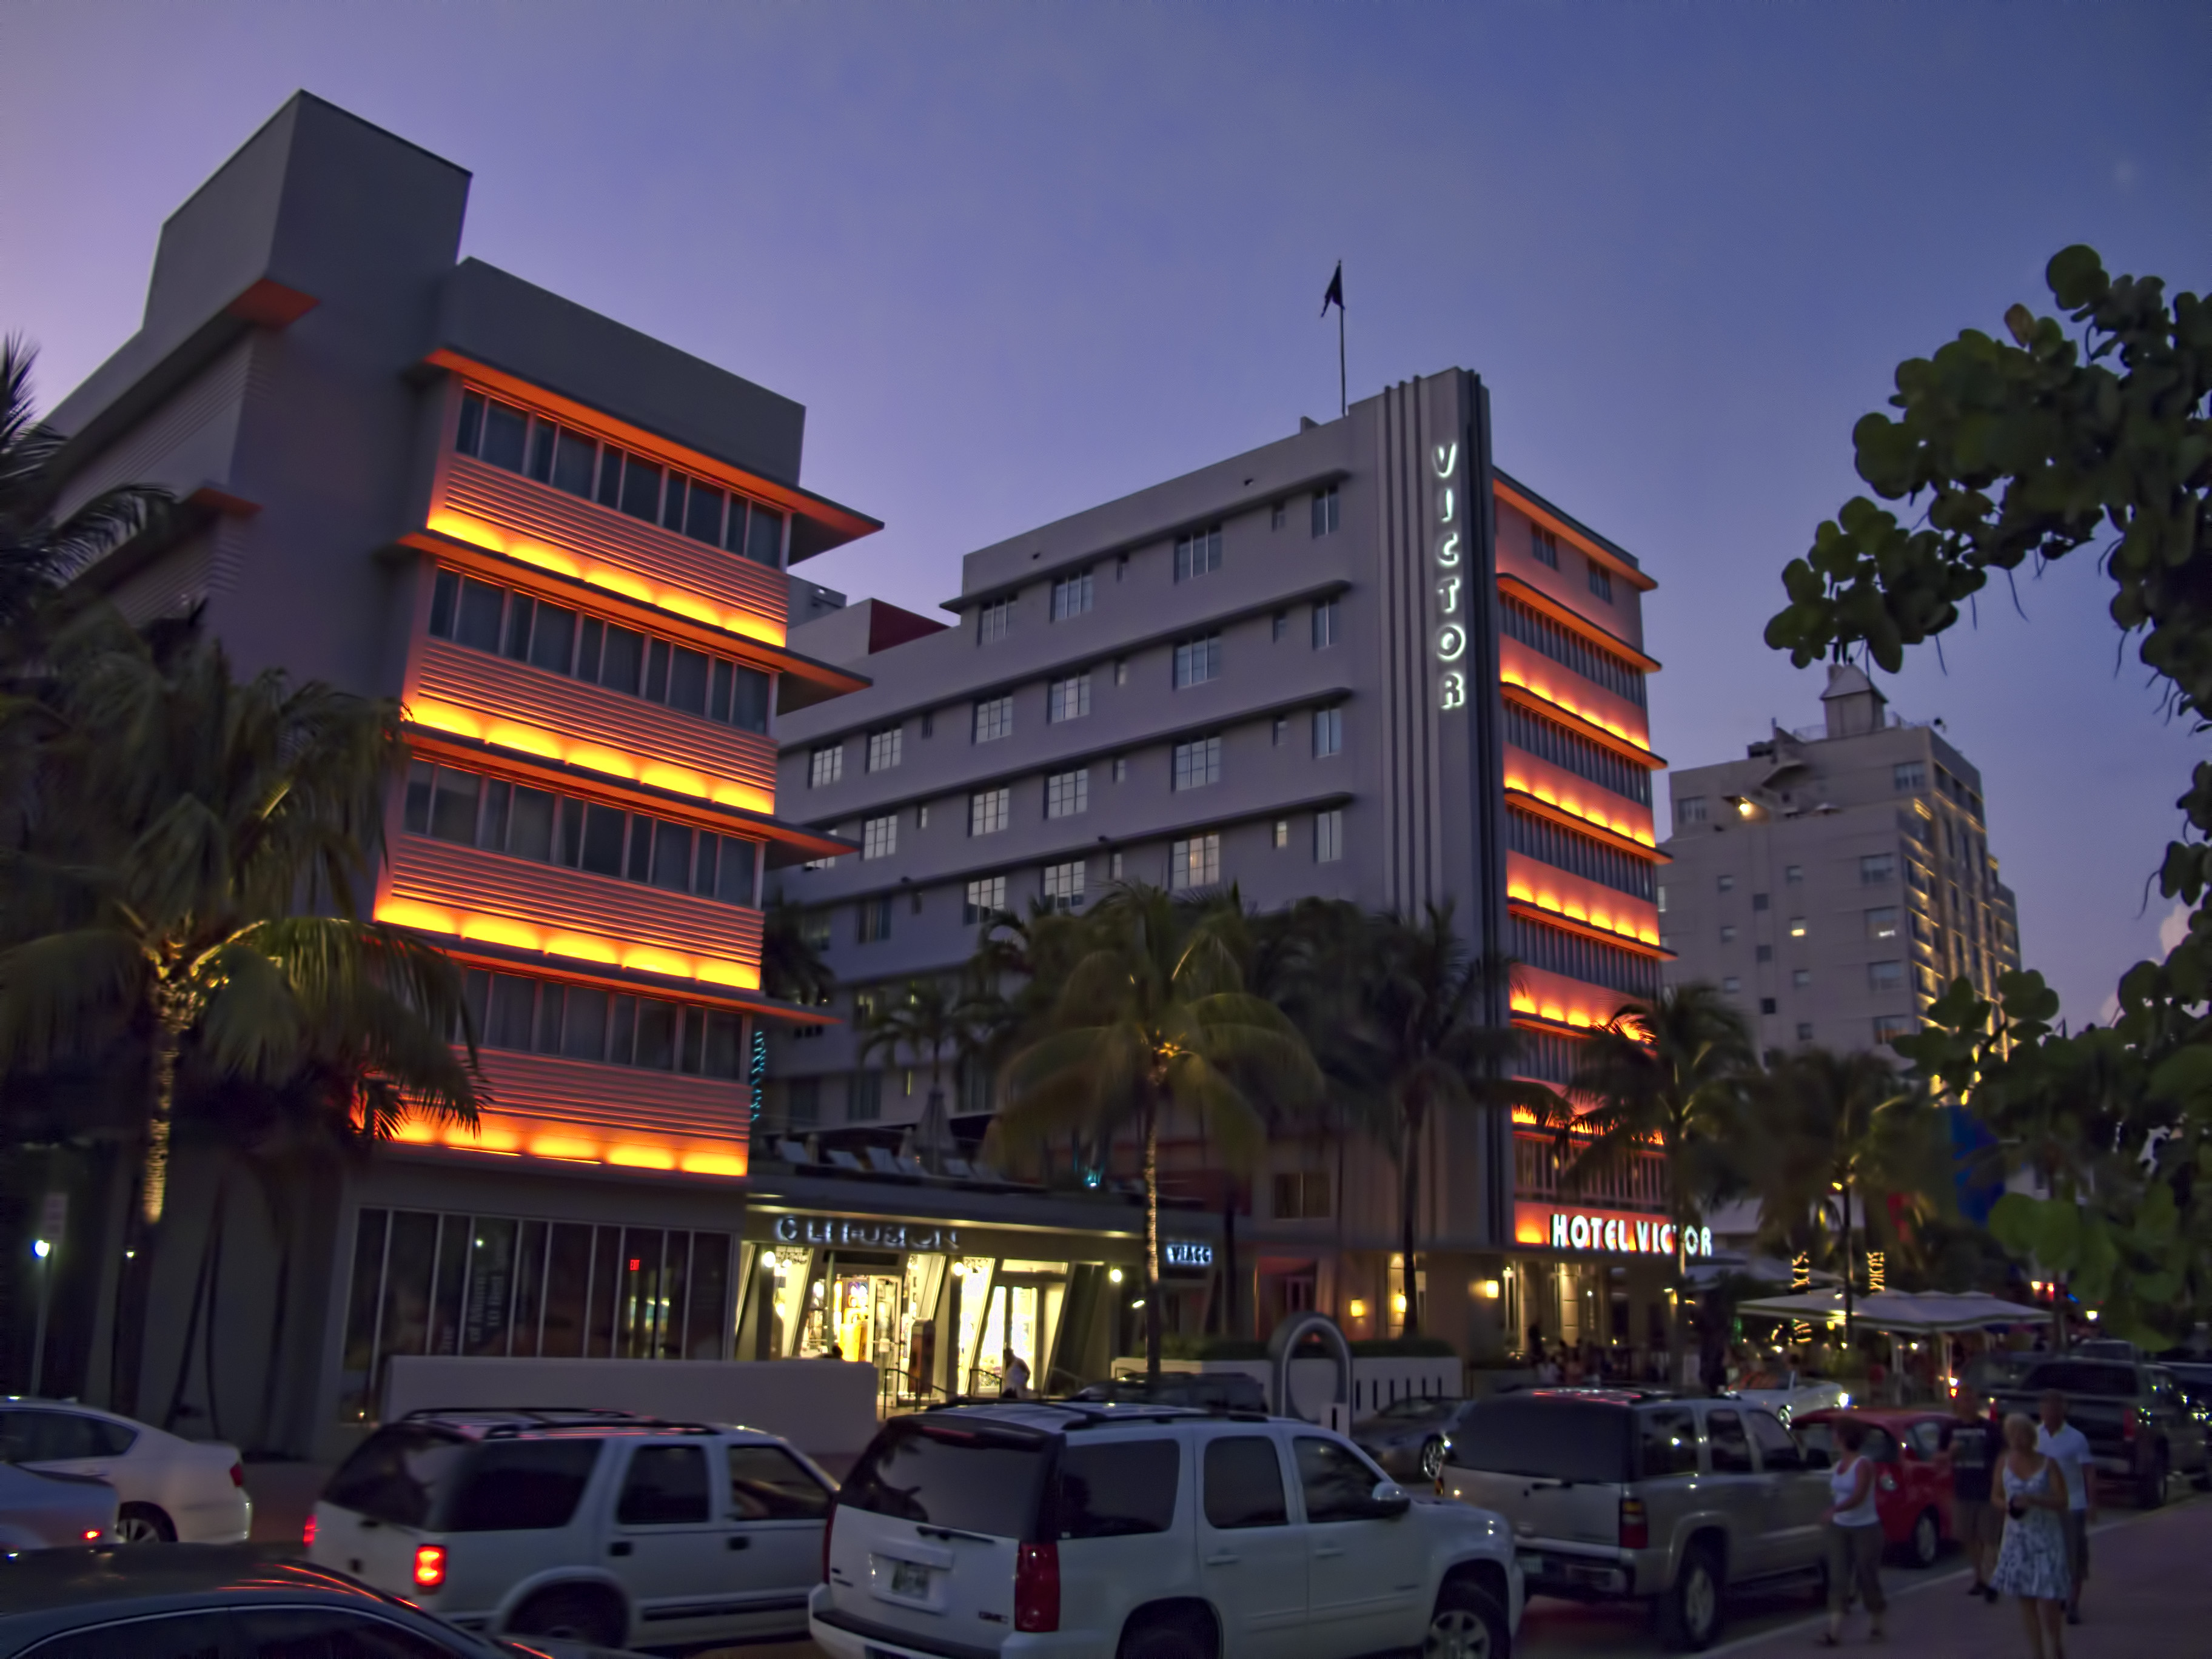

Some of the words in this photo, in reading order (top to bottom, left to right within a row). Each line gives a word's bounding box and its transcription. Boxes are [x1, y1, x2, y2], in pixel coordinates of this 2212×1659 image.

[1432, 443, 1466, 709] VICTOR
[1552, 1213, 1628, 1252] HOTEL
[1636, 1220, 1712, 1256] VICOR
